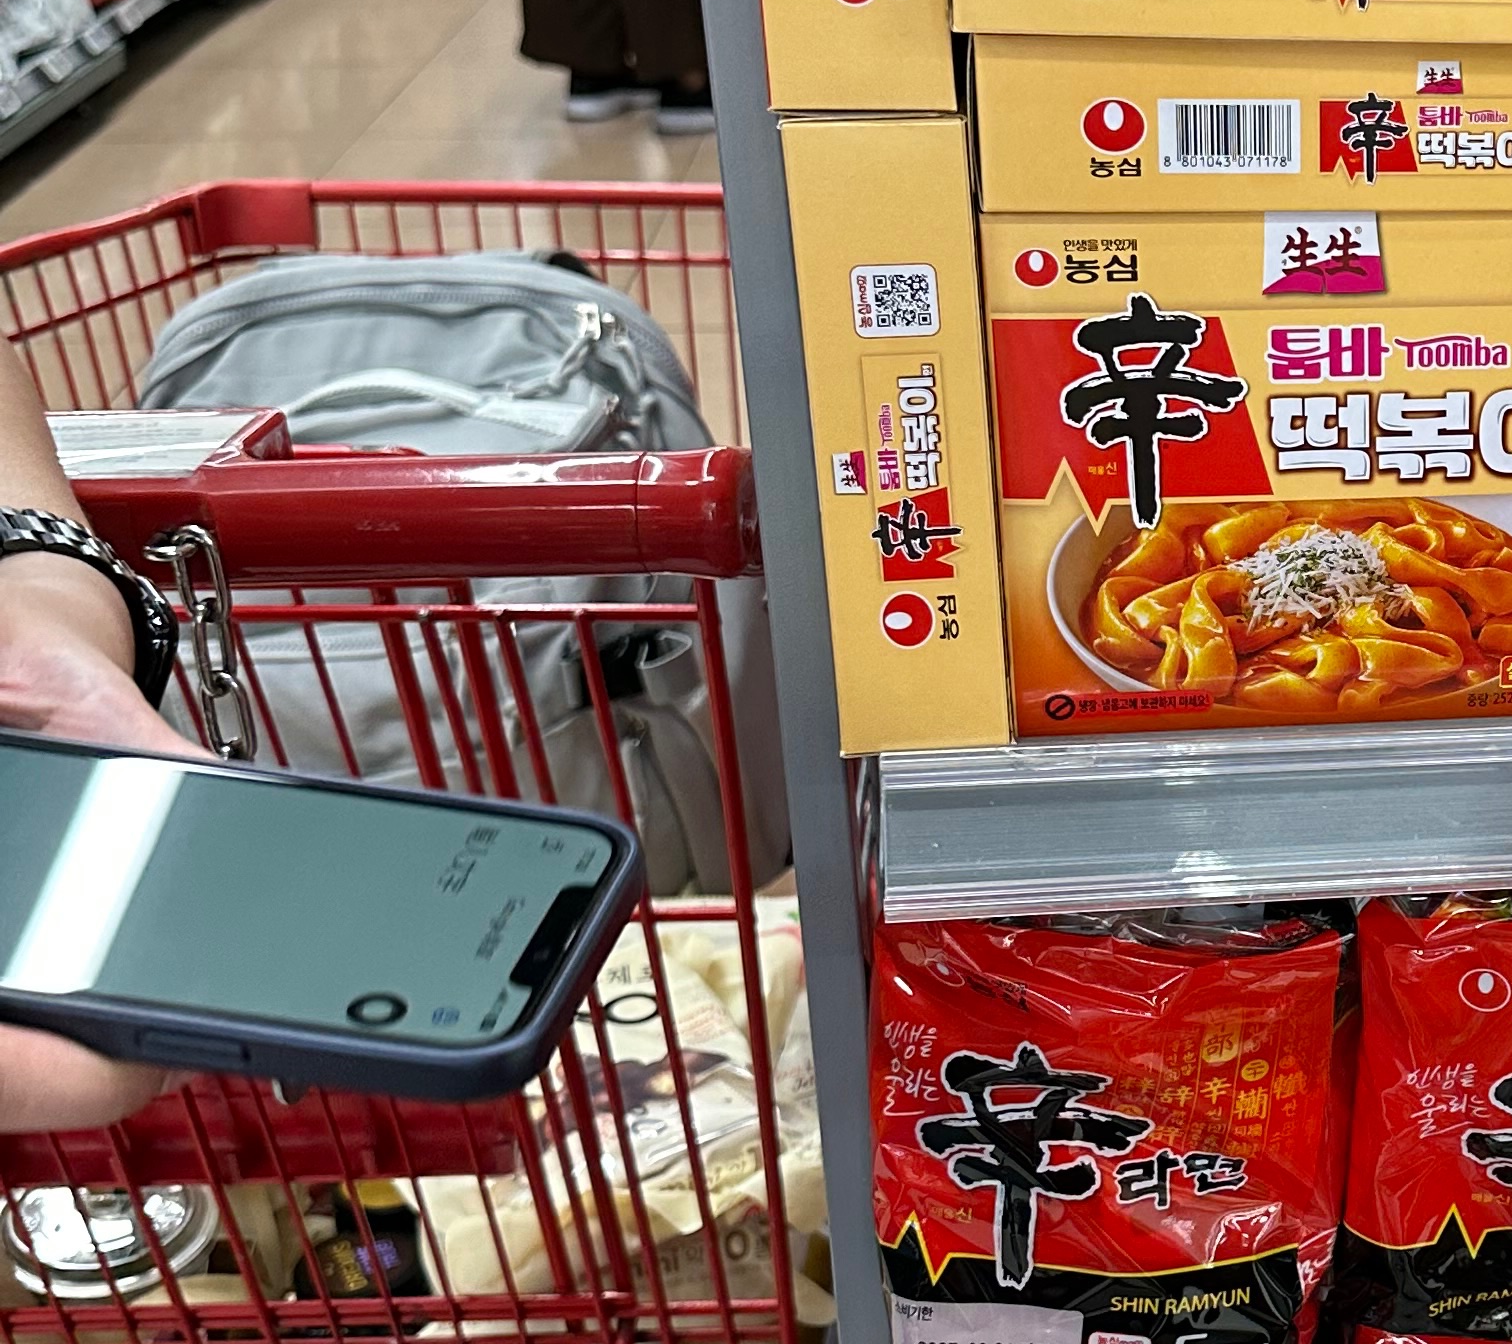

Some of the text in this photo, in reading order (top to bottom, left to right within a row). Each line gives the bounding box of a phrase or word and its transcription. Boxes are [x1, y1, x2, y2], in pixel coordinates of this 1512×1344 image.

[1341, 93, 1409, 186] 辛
[1417, 106, 1463, 128] 툼바
[1088, 156, 1143, 179] 농심
[1180, 155, 1289, 168] 801043 071178
[1063, 239, 1138, 251] 인생을 맛있게
[1063, 254, 1139, 283] 농심
[1282, 227, 1365, 277] 生生
[1267, 327, 1508, 381] 툼바 Toomba
[1062, 294, 1247, 529] 辛
[873, 497, 963, 560] 辛
[937, 594, 960, 641] 농심
[918, 1042, 1153, 1289] 辛
[1114, 1152, 1248, 1209] 라면
[1111, 1287, 1251, 1315] SHIN RAMYUN
[1428, 1294, 1473, 1318] SHIN
